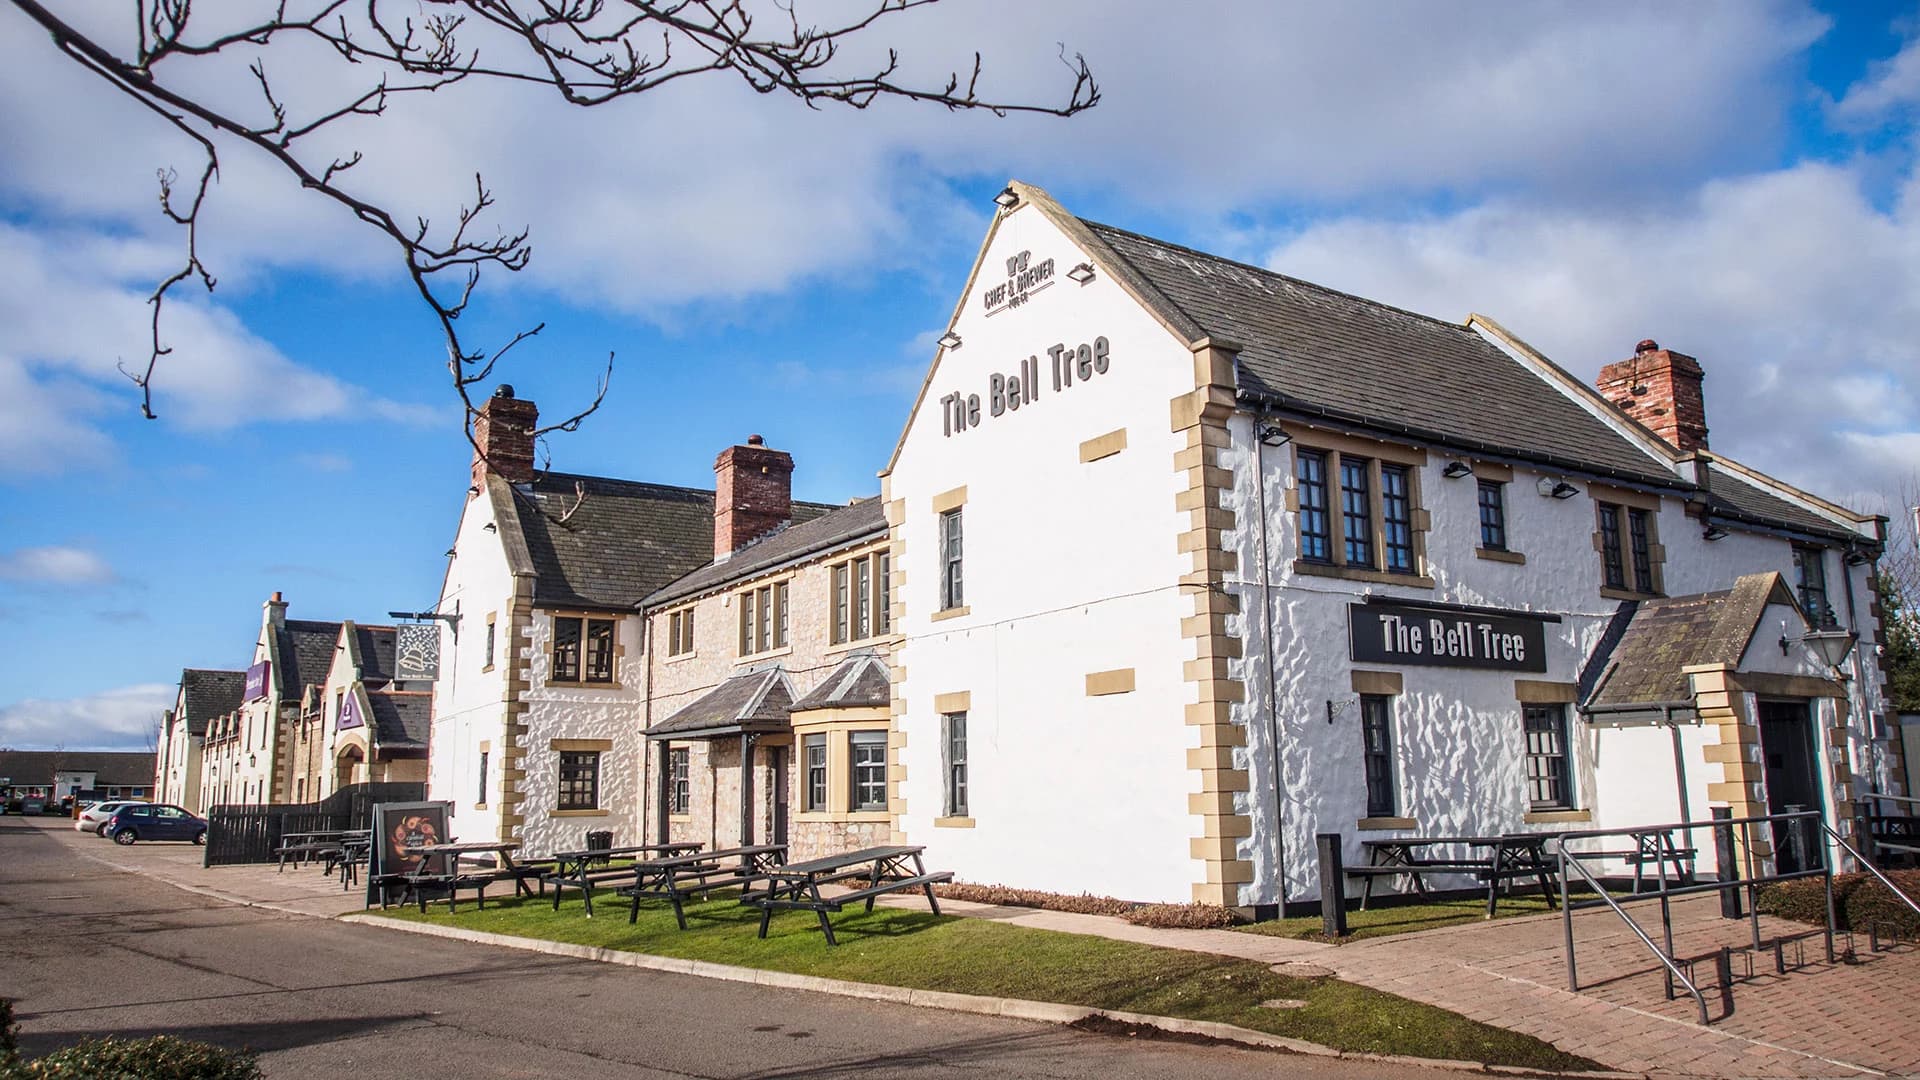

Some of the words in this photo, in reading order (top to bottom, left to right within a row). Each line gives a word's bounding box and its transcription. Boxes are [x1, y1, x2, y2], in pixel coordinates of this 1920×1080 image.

[984, 283, 1006, 310] CHEF
[1007, 279, 1015, 297] &
[1016, 258, 1055, 294] BREWER
[940, 391, 981, 438] The
[990, 355, 1039, 418] Bell
[1047, 336, 1110, 393] Tree
[1379, 614, 1422, 655] The
[1430, 618, 1474, 658] Bell
[1478, 623, 1525, 662] Tree
